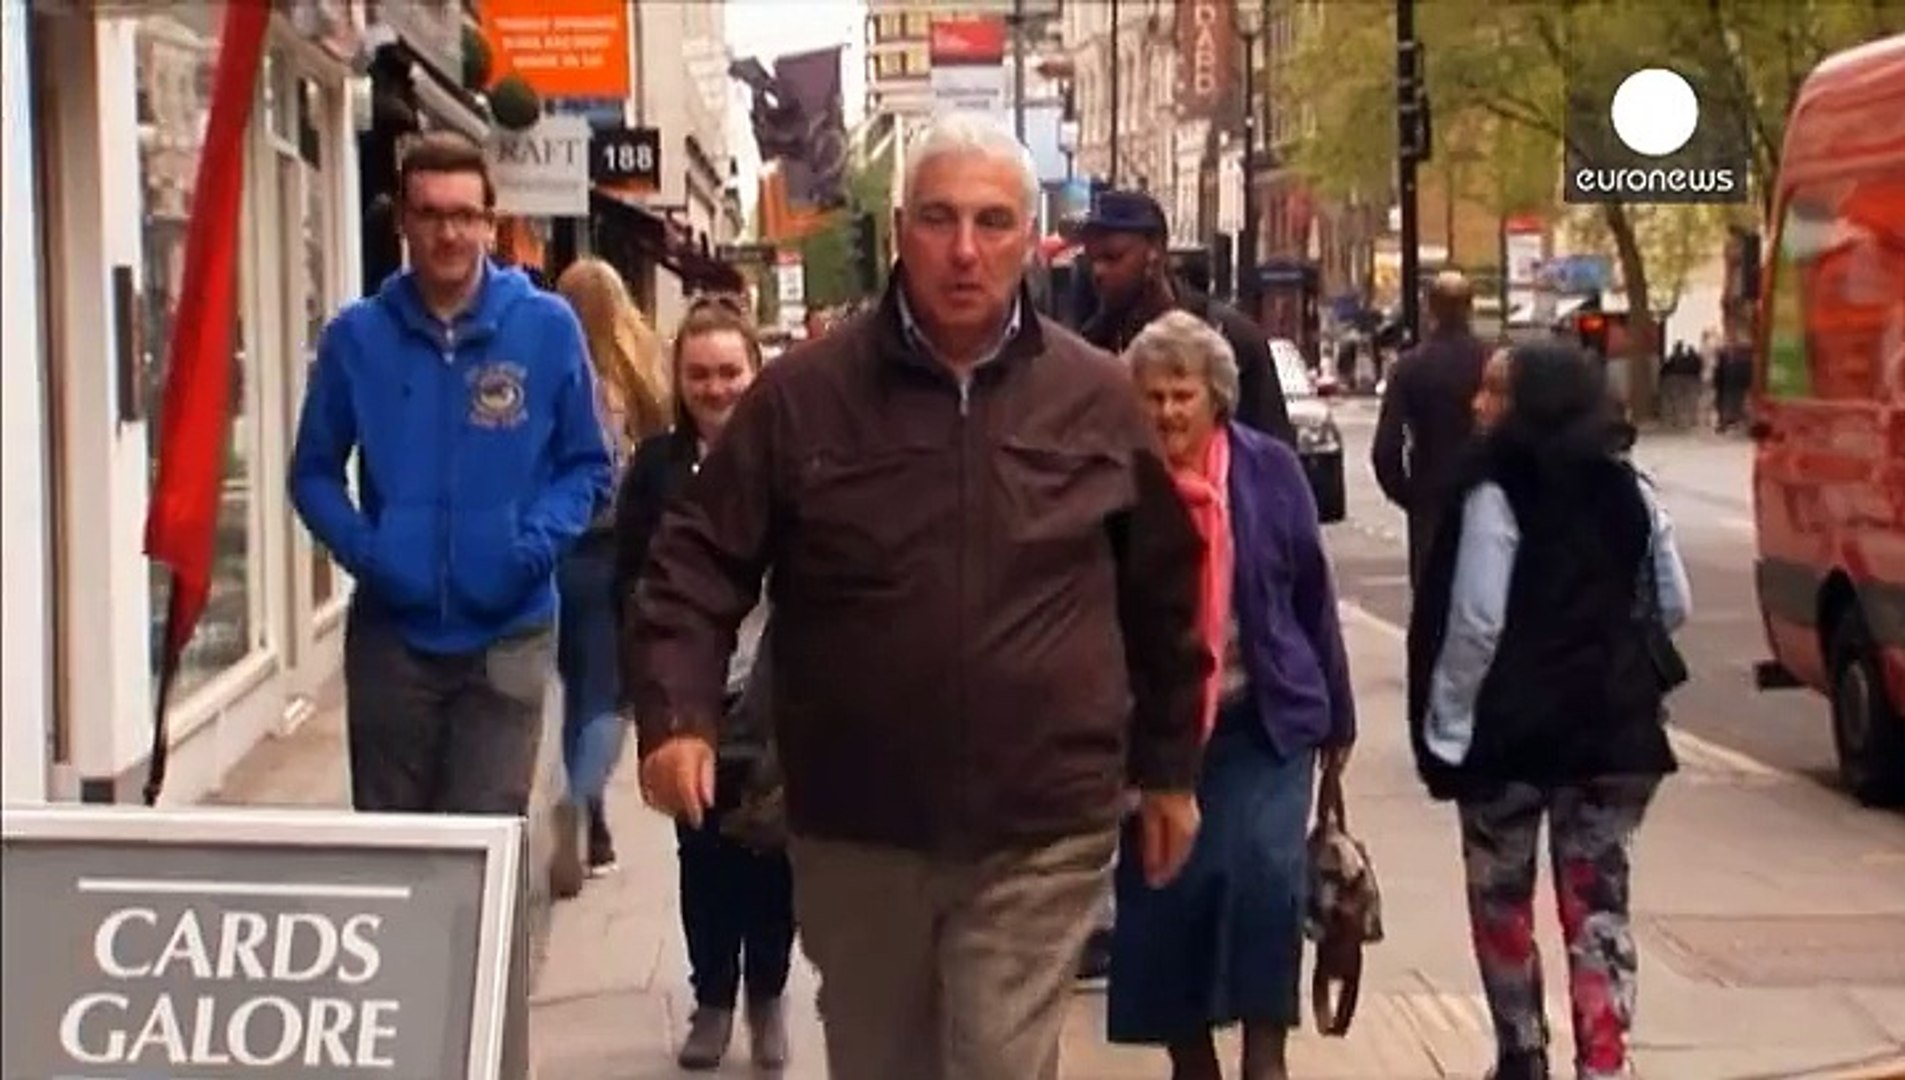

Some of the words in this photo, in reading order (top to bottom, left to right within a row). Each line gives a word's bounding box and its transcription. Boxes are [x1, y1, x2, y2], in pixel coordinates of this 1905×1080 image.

[602, 142, 652, 172] 188
[93, 907, 384, 985] CARDS
[58, 991, 400, 1068] GALORE
